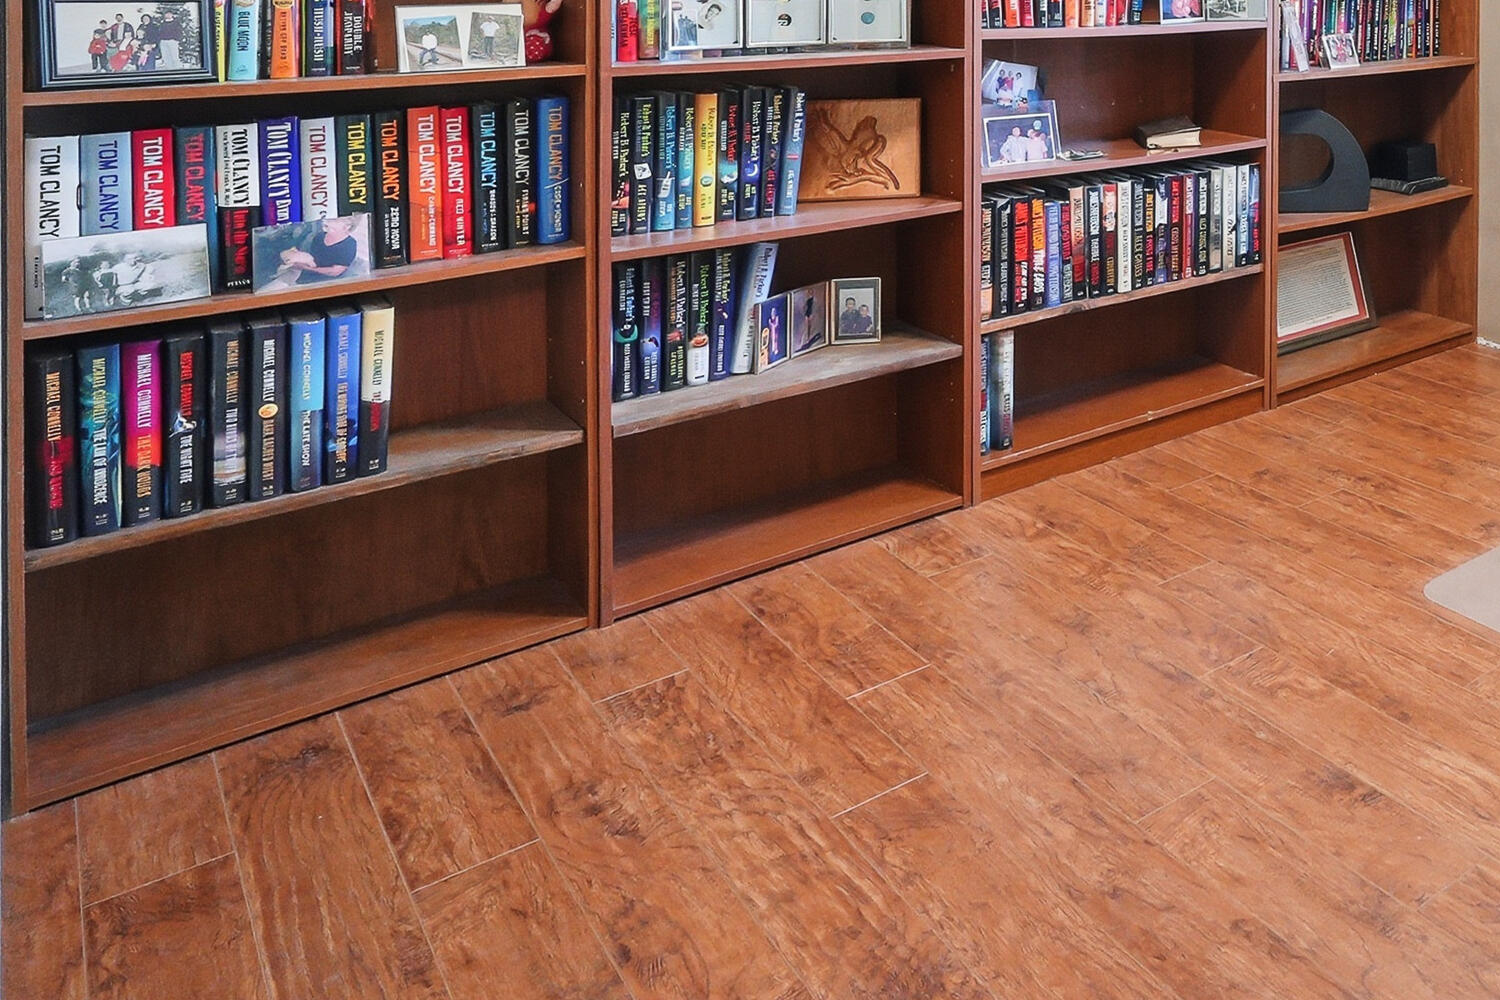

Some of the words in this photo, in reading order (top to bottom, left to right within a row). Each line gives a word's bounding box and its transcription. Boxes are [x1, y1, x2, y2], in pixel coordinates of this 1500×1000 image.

[238, 11, 251, 29] BLUE
[312, 7, 325, 62] HUSH-HUSH
[343, 10, 354, 57] JEOPARDY
[352, 15, 363, 52] DOUBLE
[236, 31, 250, 52] MOON
[380, 119, 398, 147] TOM
[417, 113, 435, 142] TOM
[446, 115, 464, 142] TOM
[480, 111, 497, 138] TOM
[514, 109, 530, 137] TOM
[547, 106, 563, 131] TOM
[185, 133, 204, 162] TOM
[231, 128, 249, 155] TOM
[266, 121, 292, 150] TOM
[309, 125, 326, 153] TOM
[347, 121, 365, 150] TOM
[40, 144, 61, 177] TOM
[98, 140, 118, 170] TOM
[142, 136, 163, 167] TOM
[480, 139, 498, 189] CLANCY
[514, 138, 531, 186] CLANCY
[547, 133, 564, 181] CLANCY
[232, 158, 251, 205] CLANCY
[267, 151, 292, 198] CLANCY
[310, 156, 329, 209] CLANCY
[347, 152, 367, 205] CLANCY
[381, 149, 401, 201] CLANCY
[419, 143, 437, 195] CLANCY
[446, 144, 465, 195] CLANCY
[98, 174, 119, 231] CLANCY
[142, 170, 164, 225] CLANCY
[185, 165, 206, 221] CLANCY
[39, 180, 60, 238] CLANCY
[390, 206, 400, 226] ZERO
[455, 216, 467, 246] WINTER
[262, 338, 276, 368] MICHAEL
[302, 332, 312, 363] MICHAEL
[337, 324, 349, 351] MICHAEL
[180, 351, 193, 381] MICHAEL
[226, 339, 239, 369] MICHAEL
[92, 357, 107, 388] MICHAEL
[136, 353, 152, 388] MICHAEL
[262, 368, 276, 402] CONNELLY
[46, 371, 61, 404] MICHAEL
[180, 383, 193, 416] CONNELLY
[225, 370, 239, 404] CONNELLY
[92, 389, 107, 425] CONNELLY
[136, 389, 152, 429] CONNELLY
[46, 405, 62, 442] CONNELLY
[301, 425, 311, 444] LATE
[136, 434, 152, 450] THE
[301, 444, 311, 466] SHOW
[136, 450, 152, 471] DARK
[92, 467, 108, 506] INNOCENCE
[136, 471, 152, 498] HOURS
